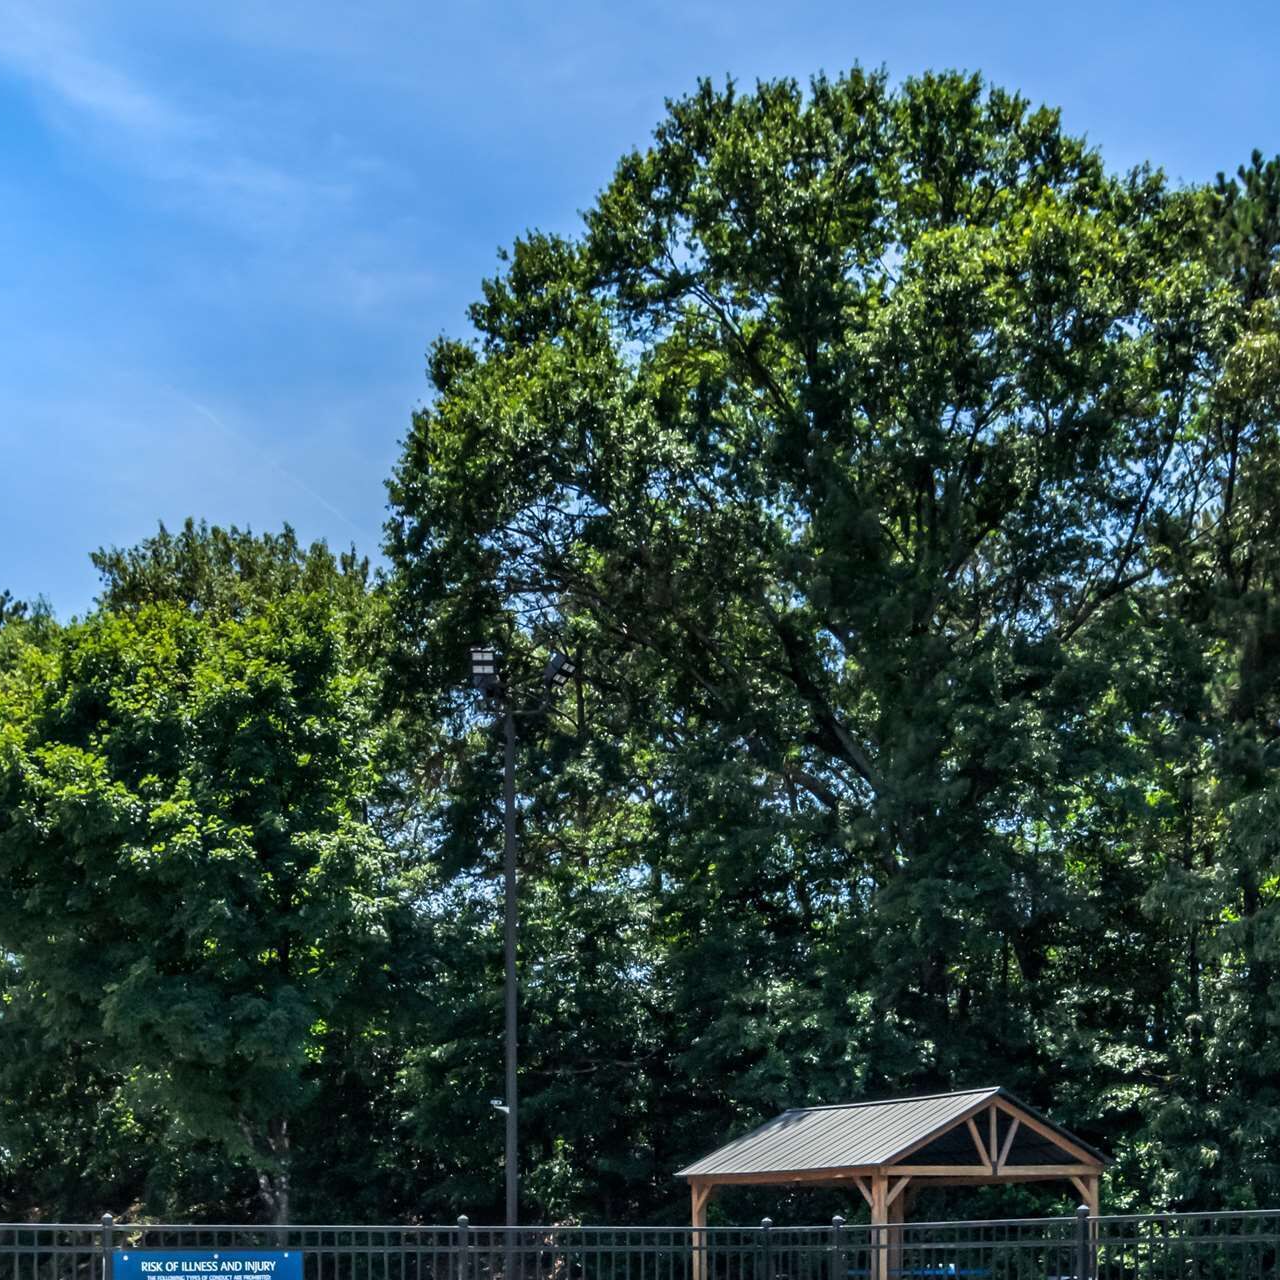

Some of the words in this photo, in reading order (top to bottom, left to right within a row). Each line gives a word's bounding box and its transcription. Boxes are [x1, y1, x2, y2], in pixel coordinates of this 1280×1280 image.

[142, 1262, 163, 1272] RISK
[166, 1262, 178, 1272] OF
[182, 1261, 218, 1272] ILLNESS
[220, 1261, 242, 1272] AND
[245, 1261, 276, 1274] INJURY
